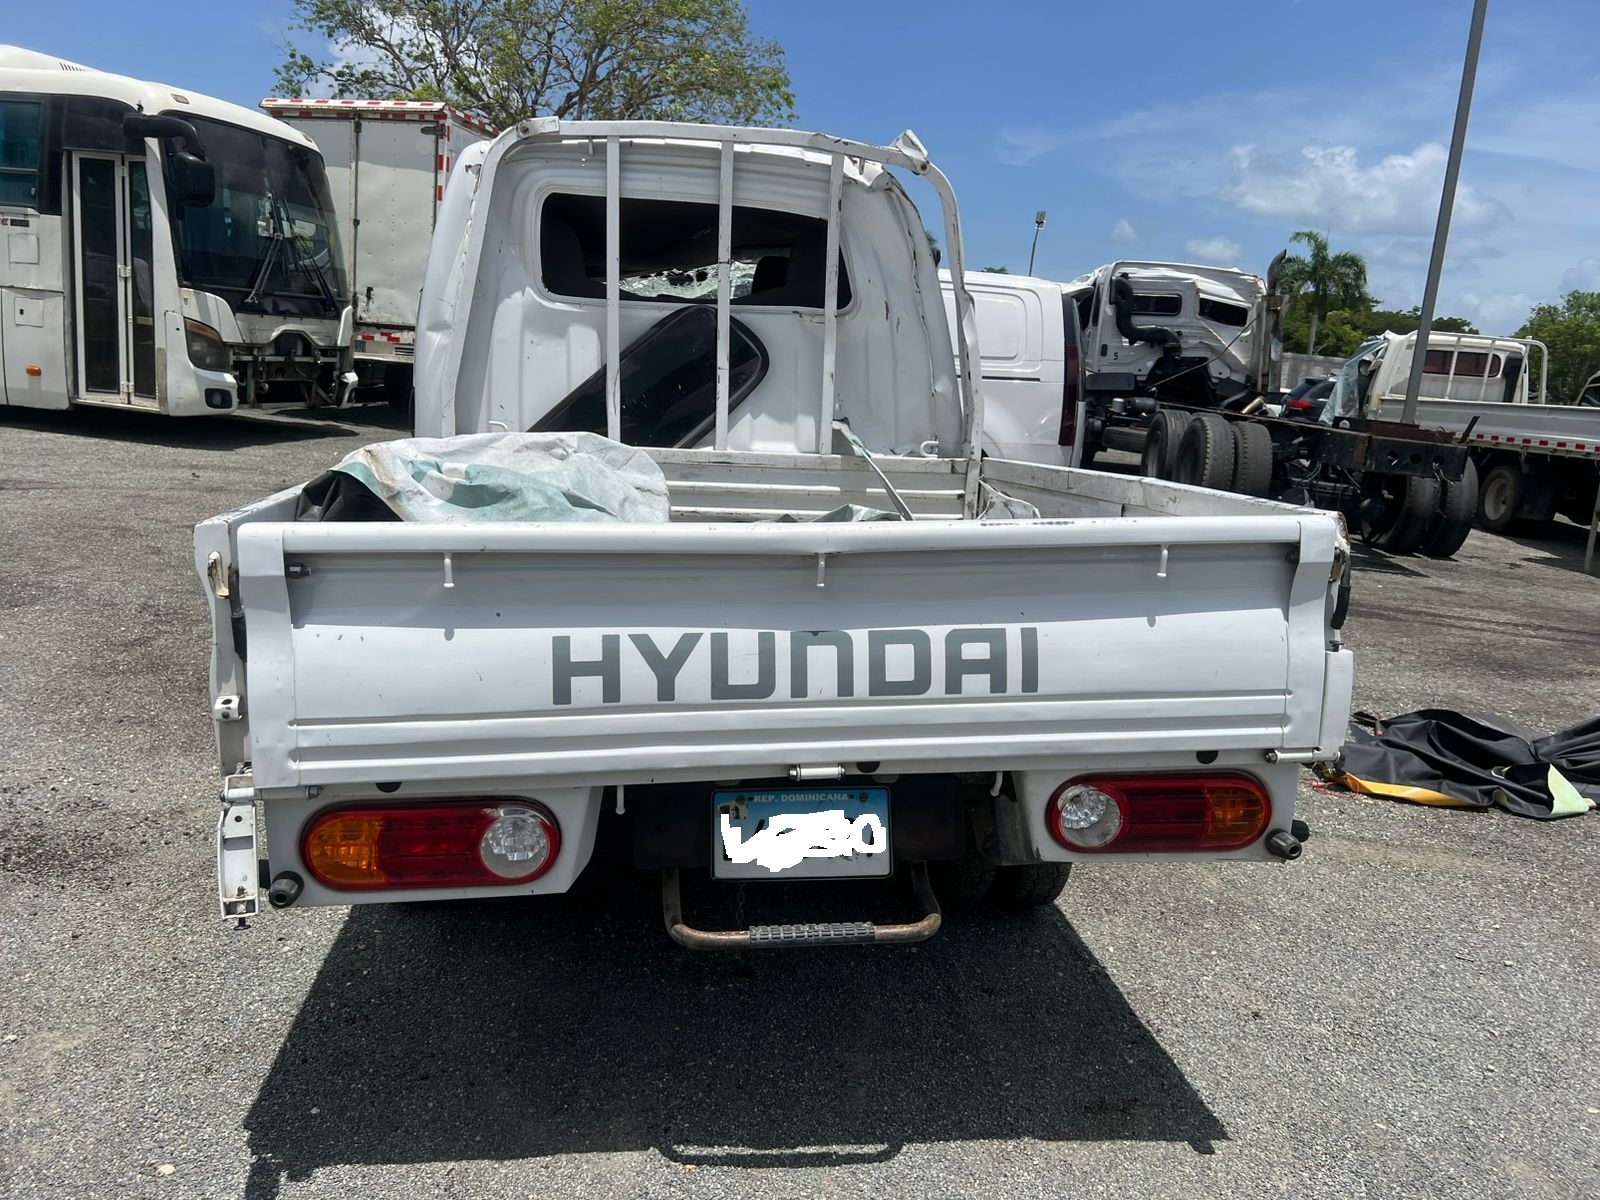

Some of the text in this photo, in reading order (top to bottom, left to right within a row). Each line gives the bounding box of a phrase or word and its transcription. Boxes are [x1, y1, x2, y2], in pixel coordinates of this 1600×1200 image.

[552, 627, 1038, 705] HYUNDAI
[753, 793, 849, 803] REP. DOMINICANA
